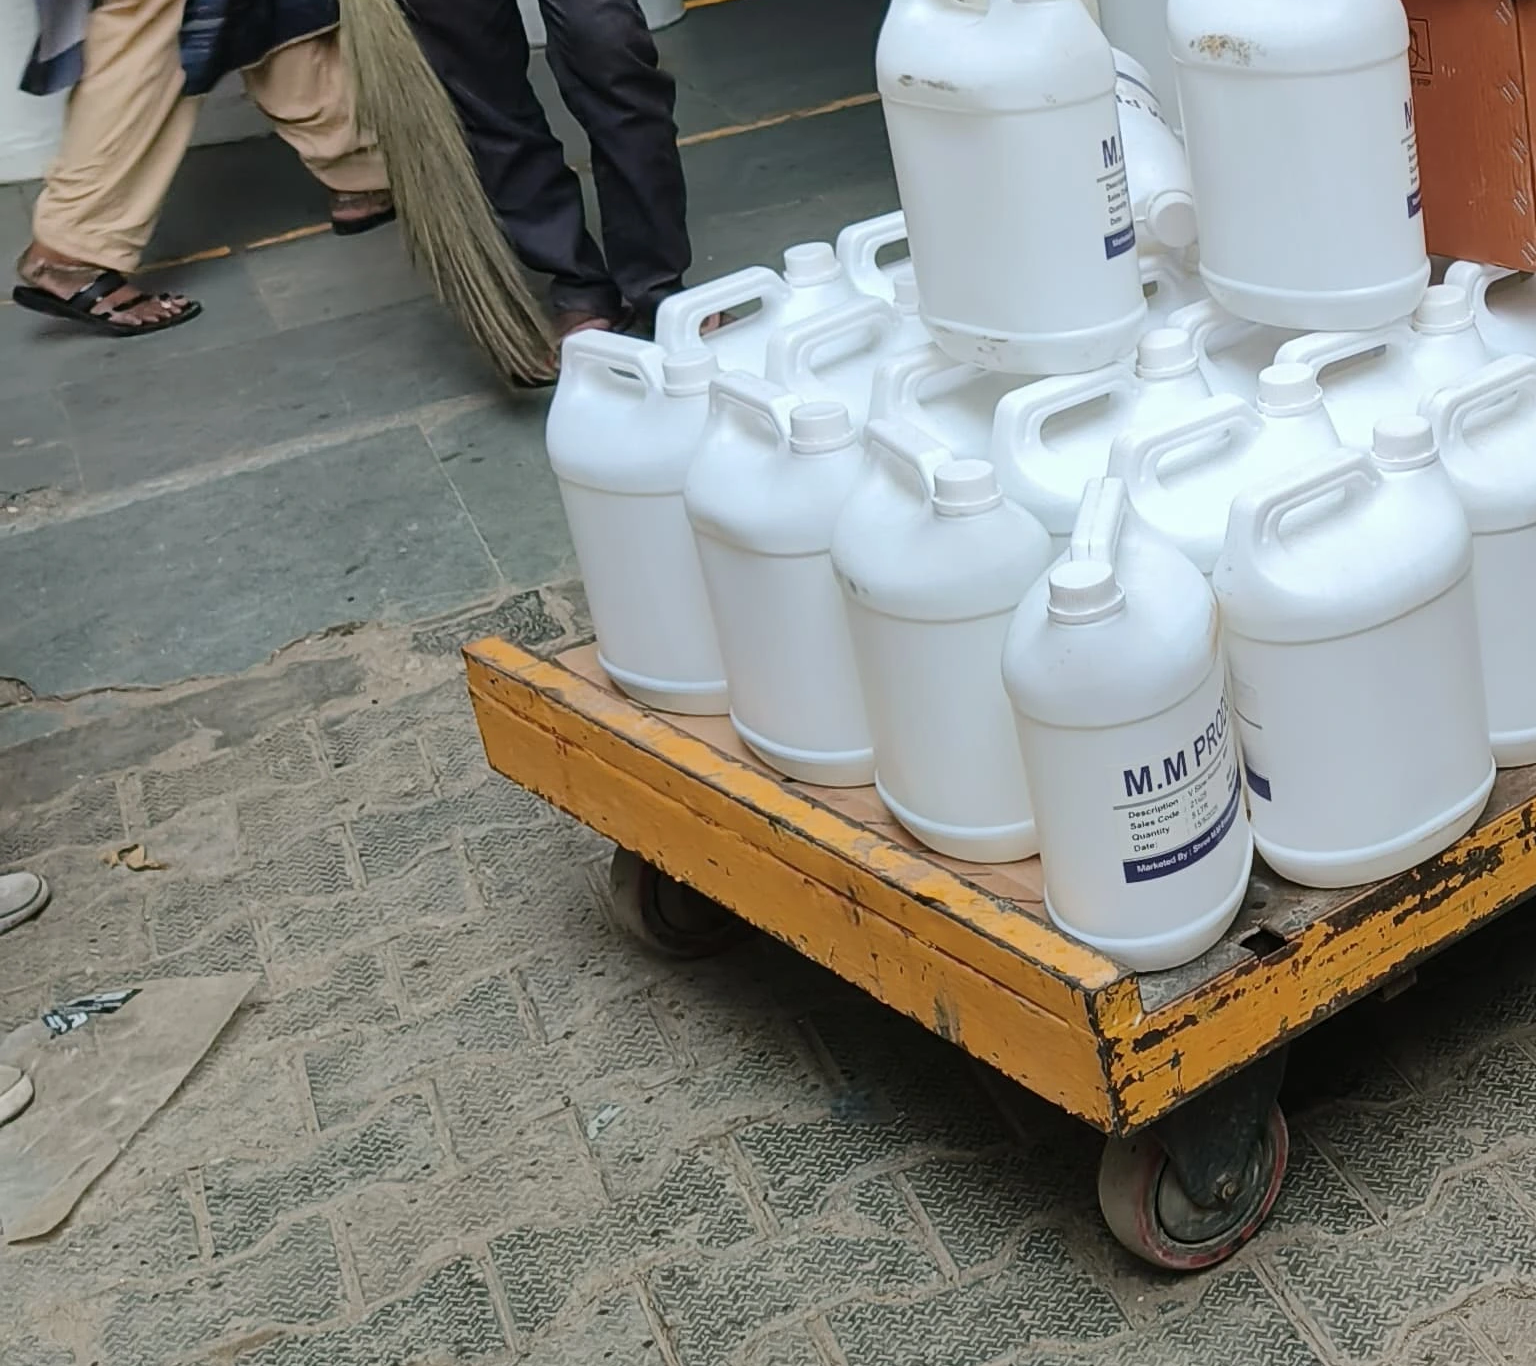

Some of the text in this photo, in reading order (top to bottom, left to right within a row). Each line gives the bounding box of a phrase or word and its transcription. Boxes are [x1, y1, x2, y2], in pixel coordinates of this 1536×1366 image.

[1123, 749, 1188, 798] M.M
[1128, 799, 1179, 819] Description
[1130, 810, 1180, 830] Sales Code
[1131, 826, 1170, 841] Quantity
[1136, 855, 1176, 873] Marketed
